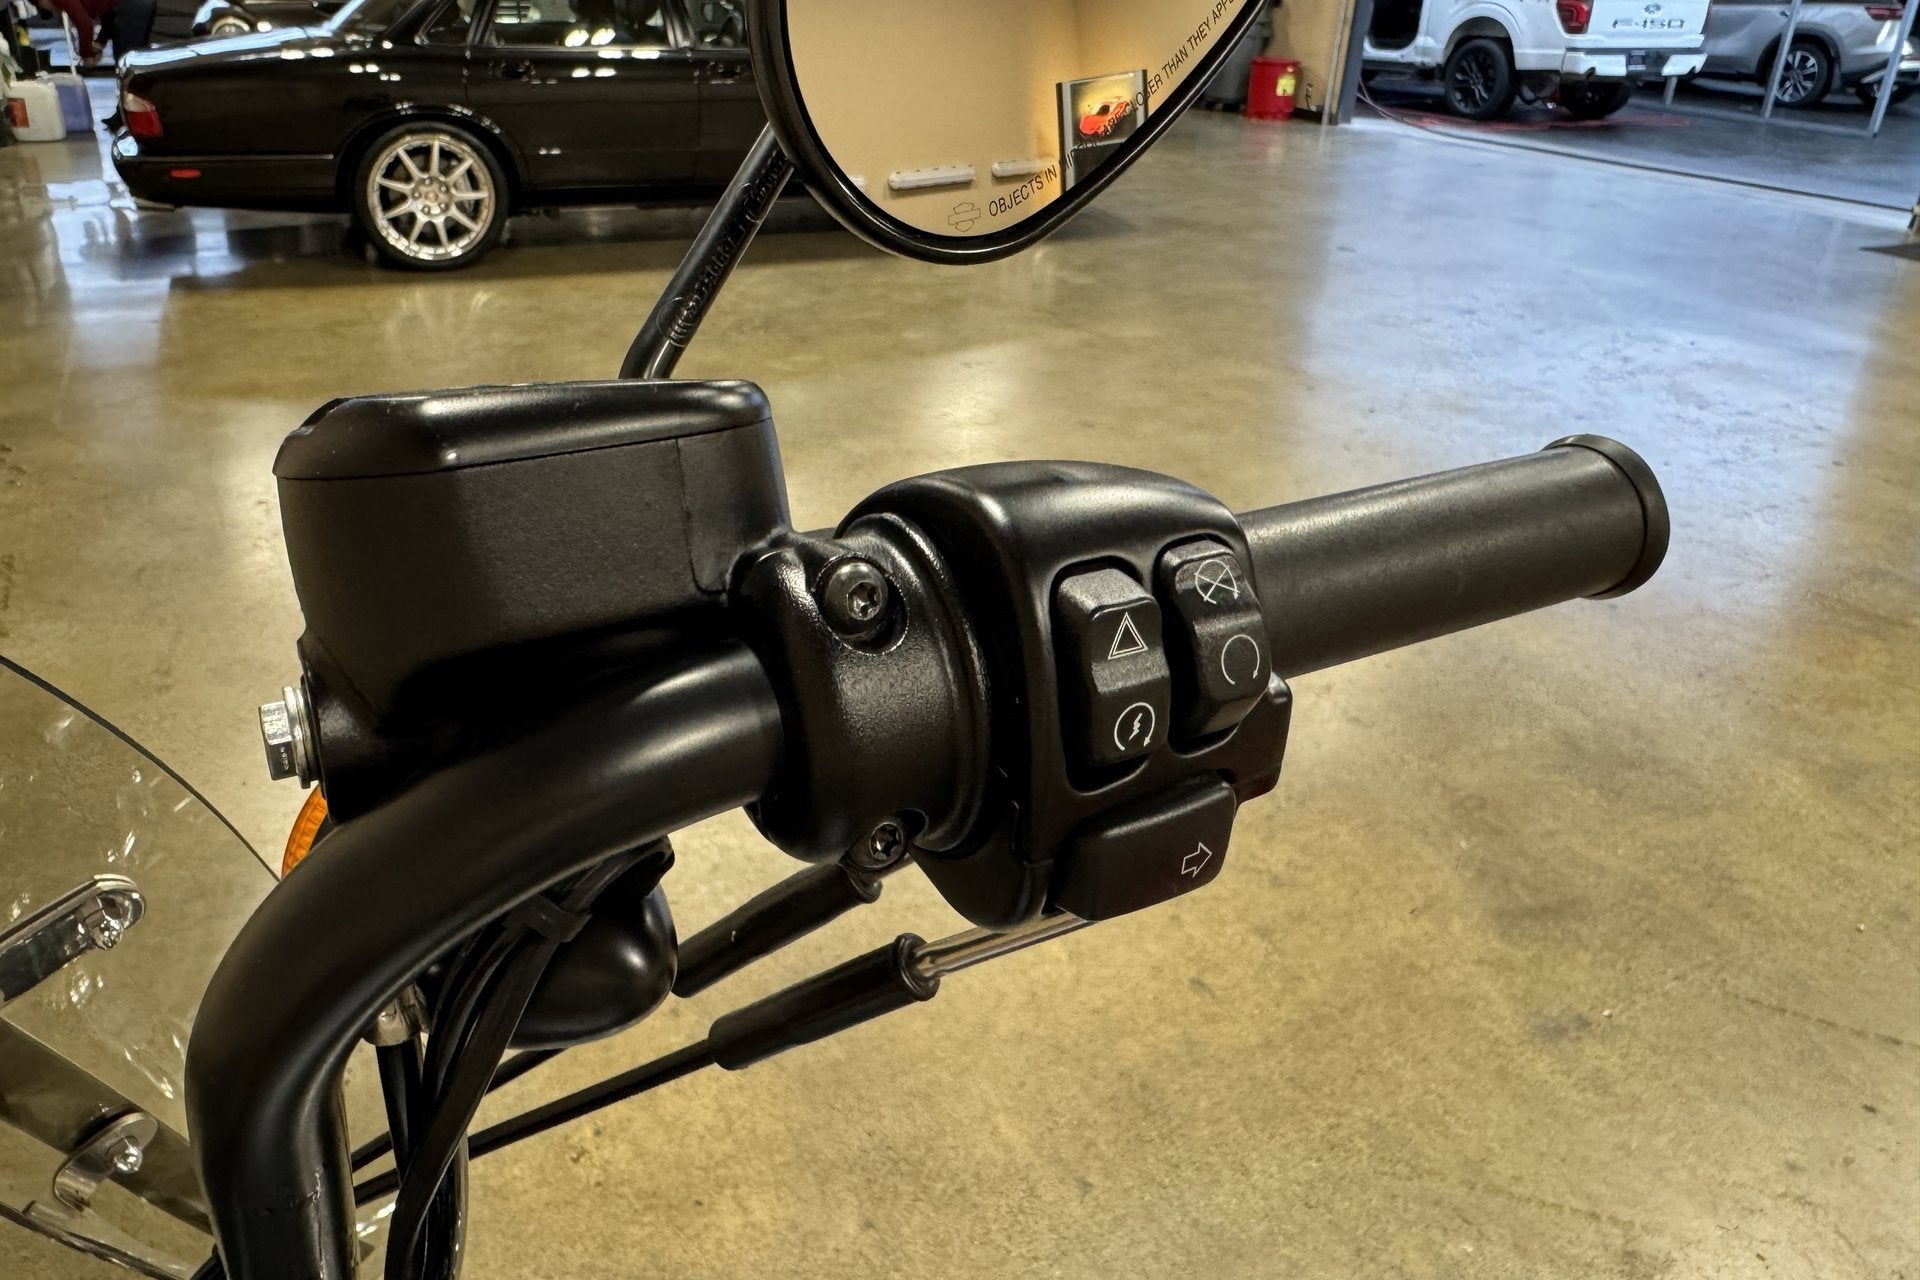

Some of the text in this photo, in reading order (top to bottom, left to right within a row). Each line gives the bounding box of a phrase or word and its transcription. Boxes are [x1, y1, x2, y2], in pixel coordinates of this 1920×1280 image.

[989, 175, 1044, 216] OBJECTS
[1045, 165, 1058, 184] IN
[1161, 45, 1189, 79] THAN
[1187, 17, 1211, 50] THEY
